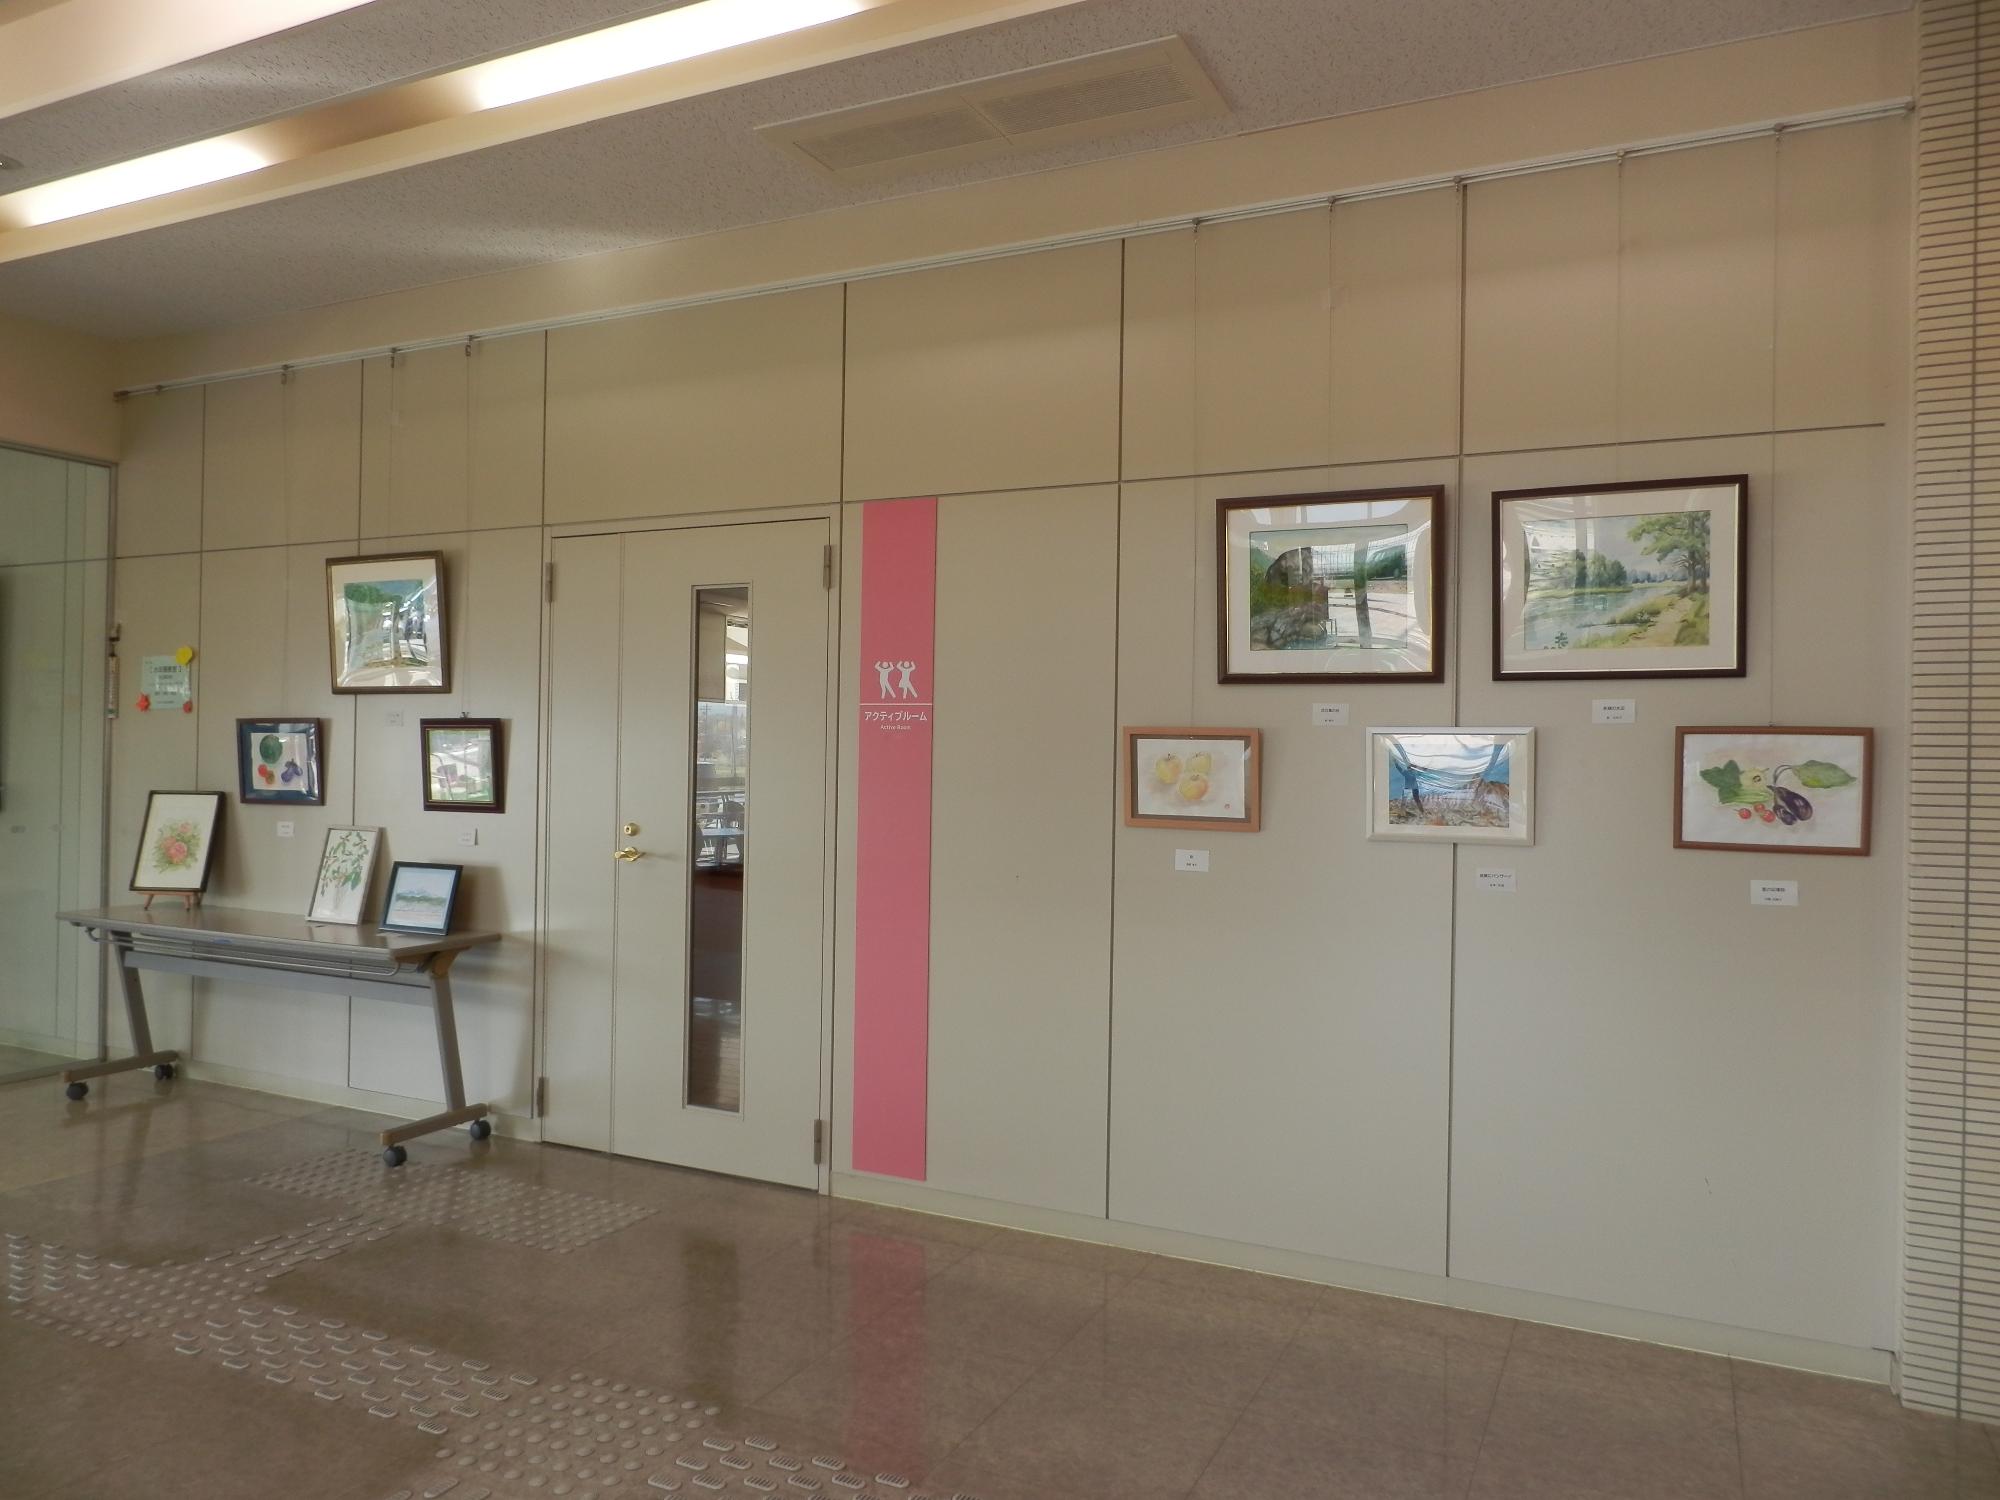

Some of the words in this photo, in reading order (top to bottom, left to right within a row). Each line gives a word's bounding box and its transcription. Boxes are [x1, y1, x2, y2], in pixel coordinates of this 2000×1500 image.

[864, 710, 928, 721] アクティブルーム
